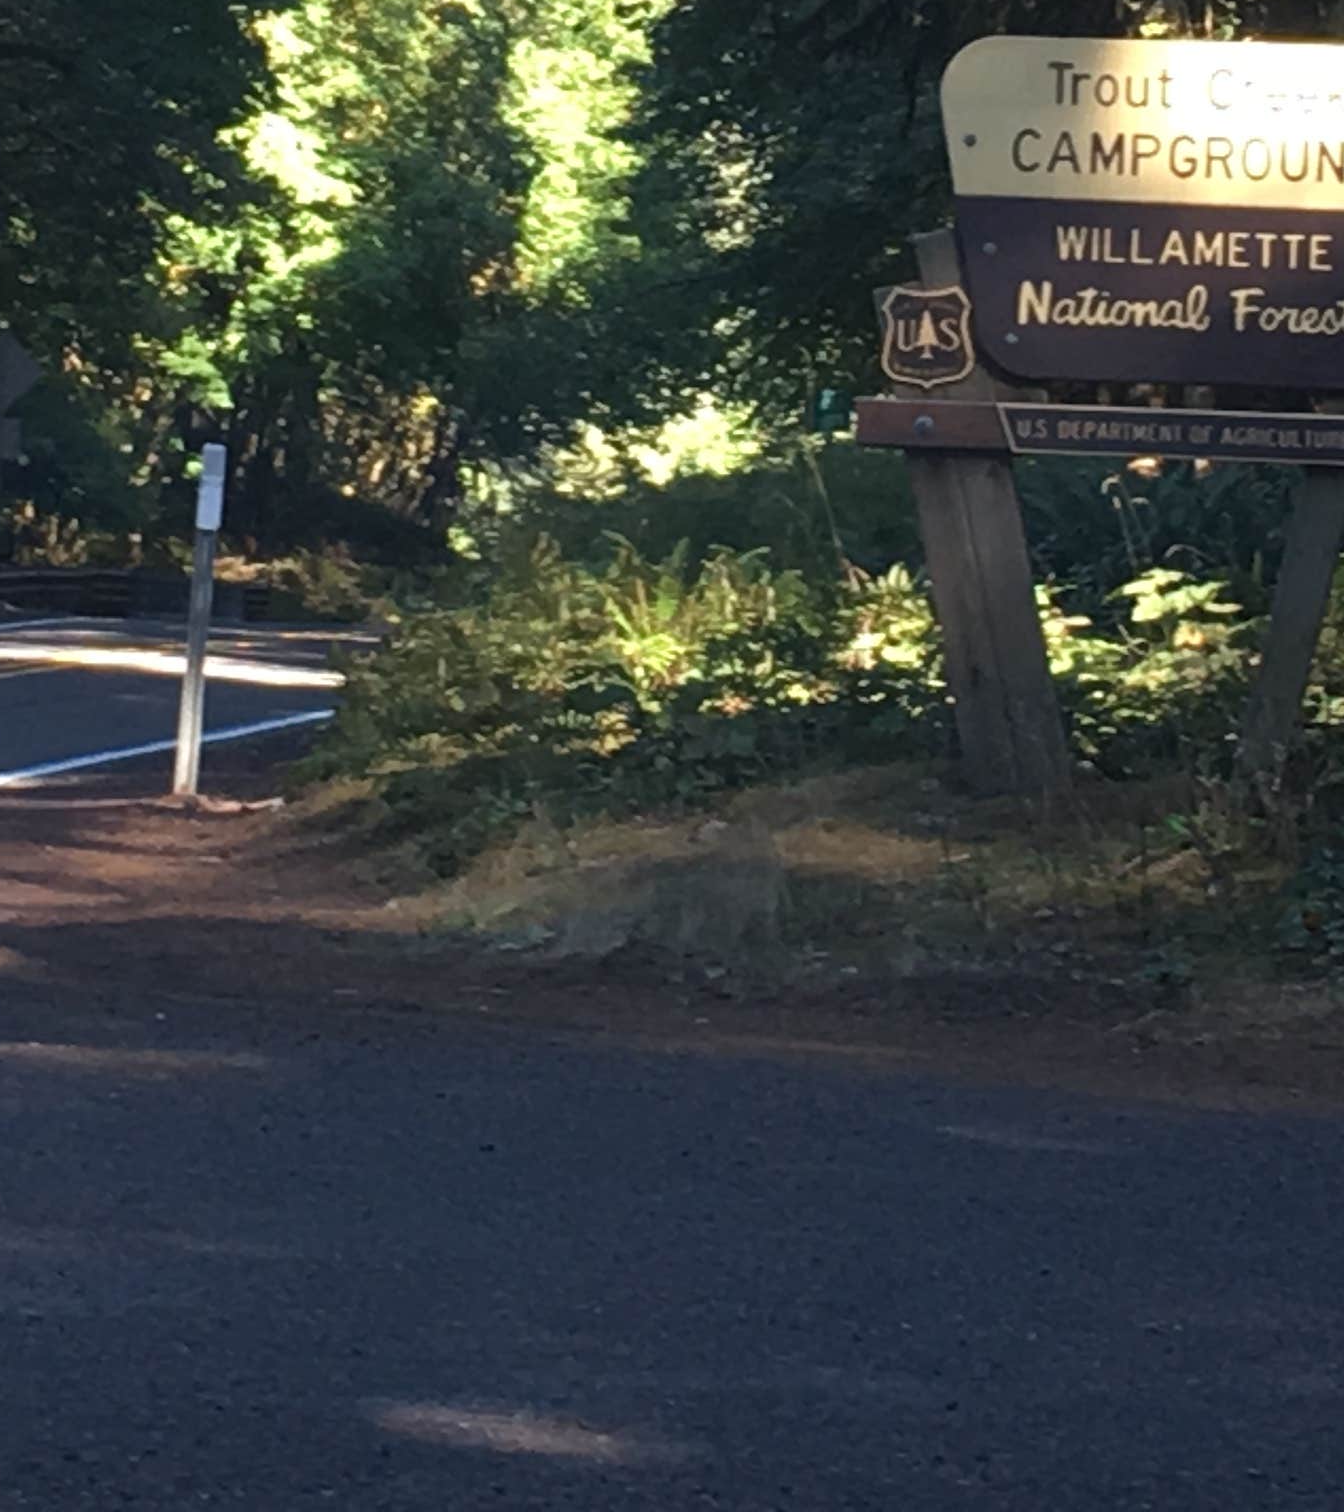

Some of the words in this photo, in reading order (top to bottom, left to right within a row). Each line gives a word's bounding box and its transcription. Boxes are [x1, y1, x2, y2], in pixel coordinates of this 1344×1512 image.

[1048, 61, 1172, 109] Trout
[1056, 225, 1333, 271] WILLAMETTE
[1017, 281, 1211, 331] National
[1057, 419, 1182, 442] DEPARTMENT
